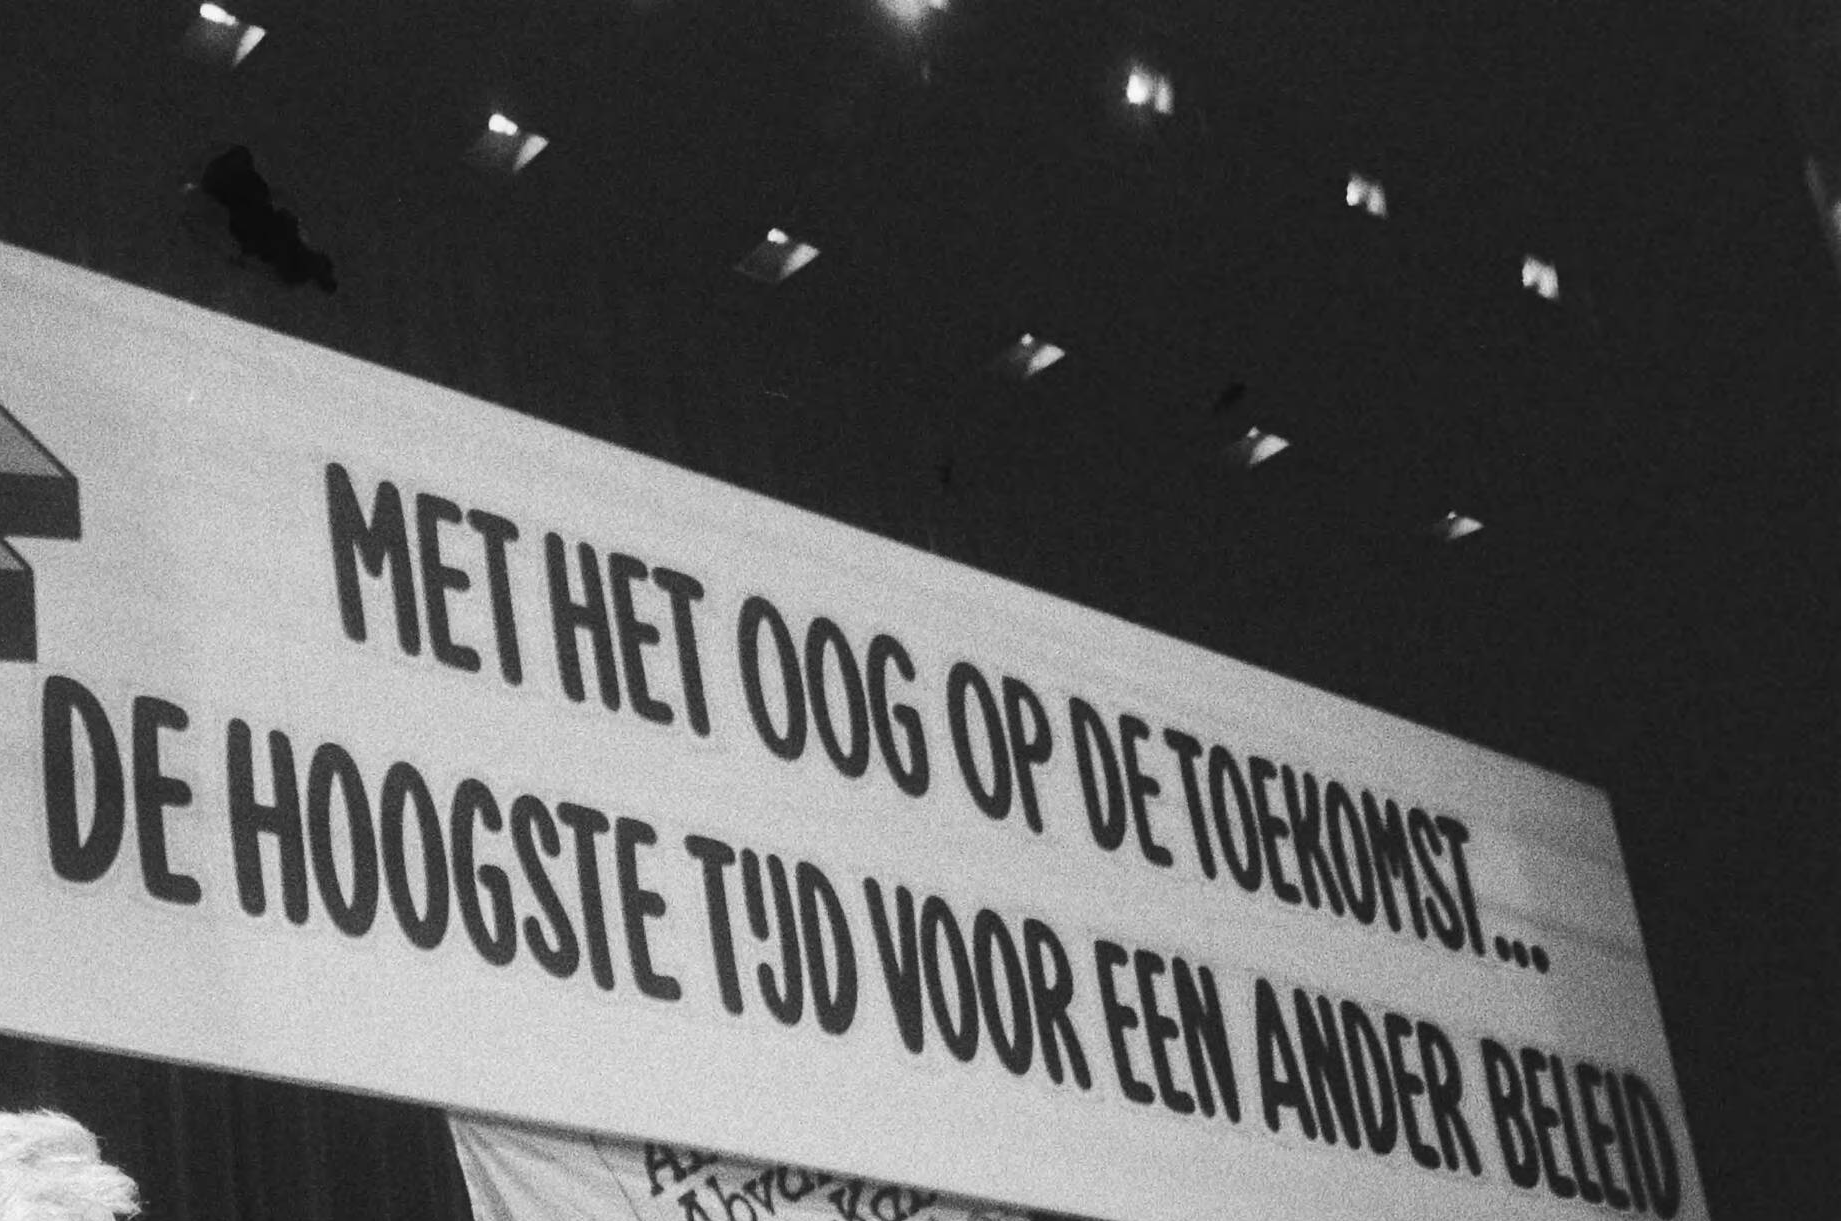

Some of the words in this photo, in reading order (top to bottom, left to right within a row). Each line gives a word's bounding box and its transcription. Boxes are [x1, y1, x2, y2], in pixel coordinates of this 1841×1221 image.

[42, 676, 202, 905] DE
[227, 718, 682, 1002] HOOGSTE
[685, 835, 858, 1035] TIJD
[865, 878, 1091, 1090] VOOR
[1095, 940, 1241, 1123] EEN
[1256, 978, 1482, 1176] ANDER
[1483, 1038, 1680, 1220] BELEID
[325, 462, 522, 685] MET
[544, 532, 711, 736] HET
[738, 596, 929, 798] OOG
[946, 661, 1053, 834] OP
[1070, 698, 1172, 867] DE
[1167, 728, 1549, 972] TOEKOMST...
